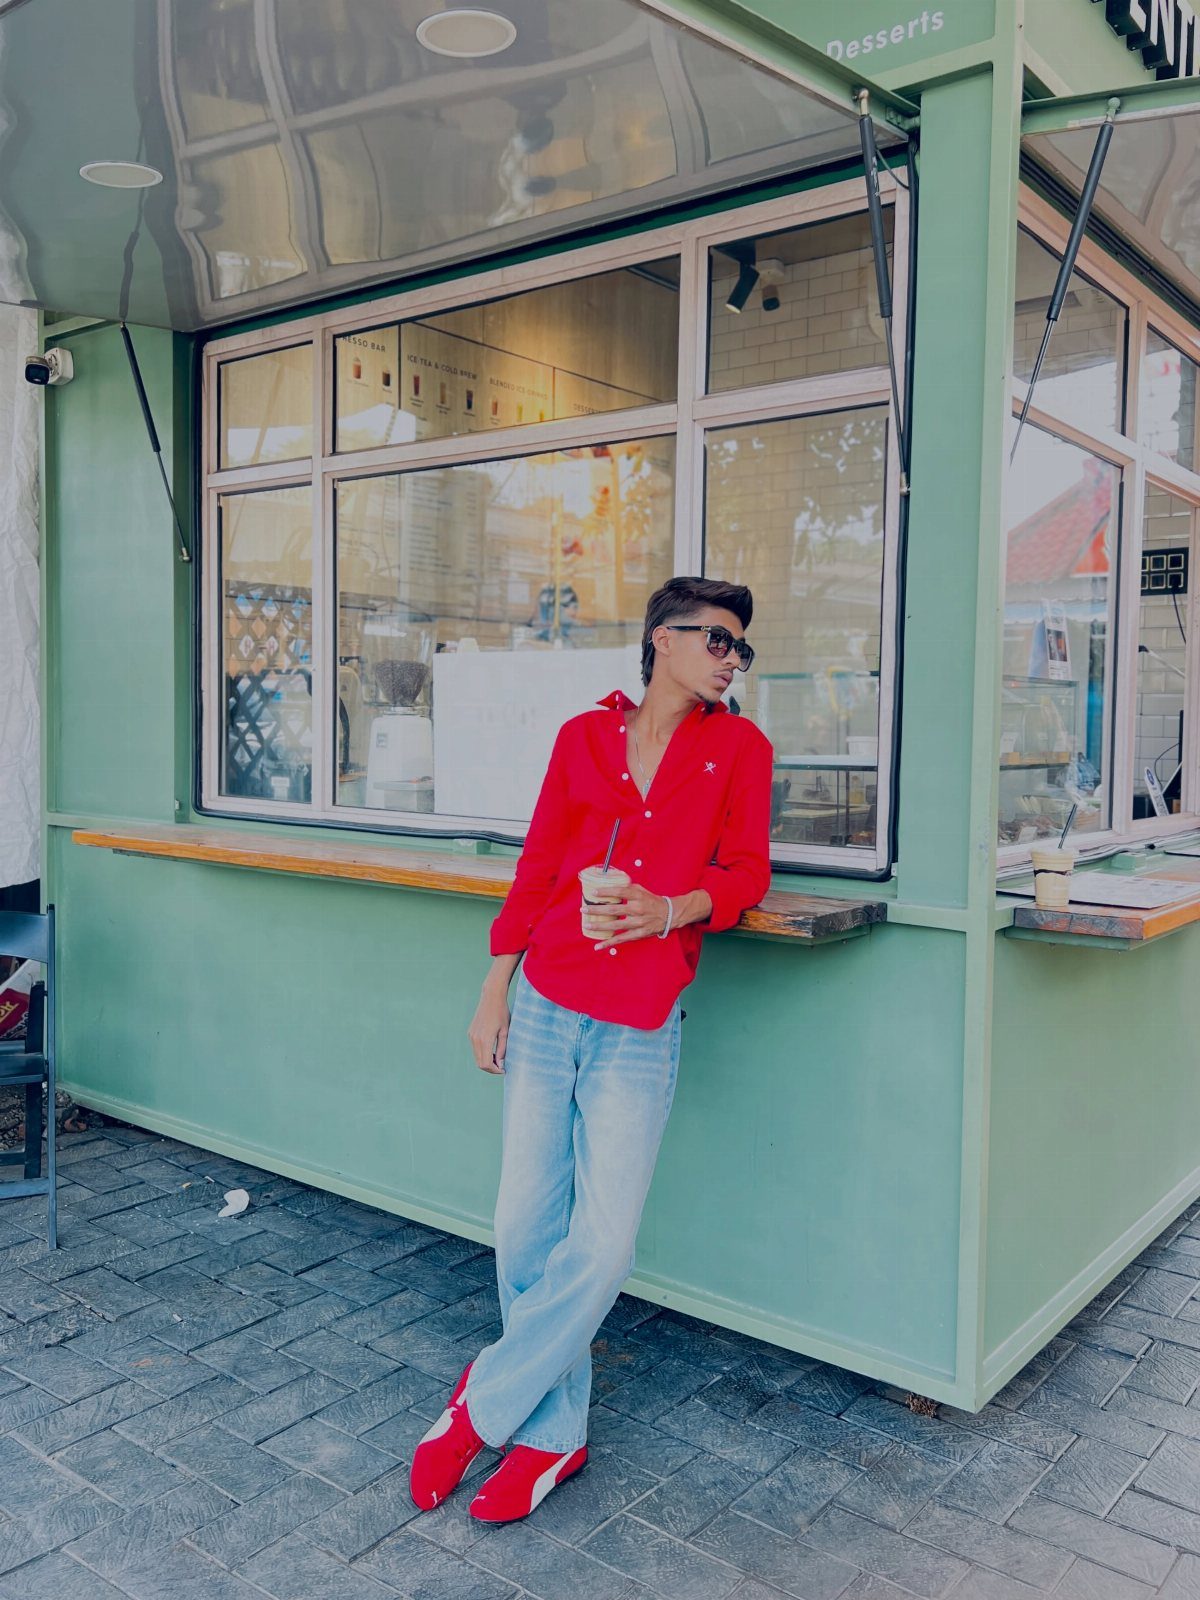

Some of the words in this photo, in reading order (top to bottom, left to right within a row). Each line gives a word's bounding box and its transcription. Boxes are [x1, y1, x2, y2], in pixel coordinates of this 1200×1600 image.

[826, 10, 944, 62] Desserts
[371, 342, 386, 353] BAR
[407, 354, 418, 364] ICE
[420, 358, 432, 368] TEA
[441, 364, 458, 375] COLD
[460, 369, 477, 380] BREW
